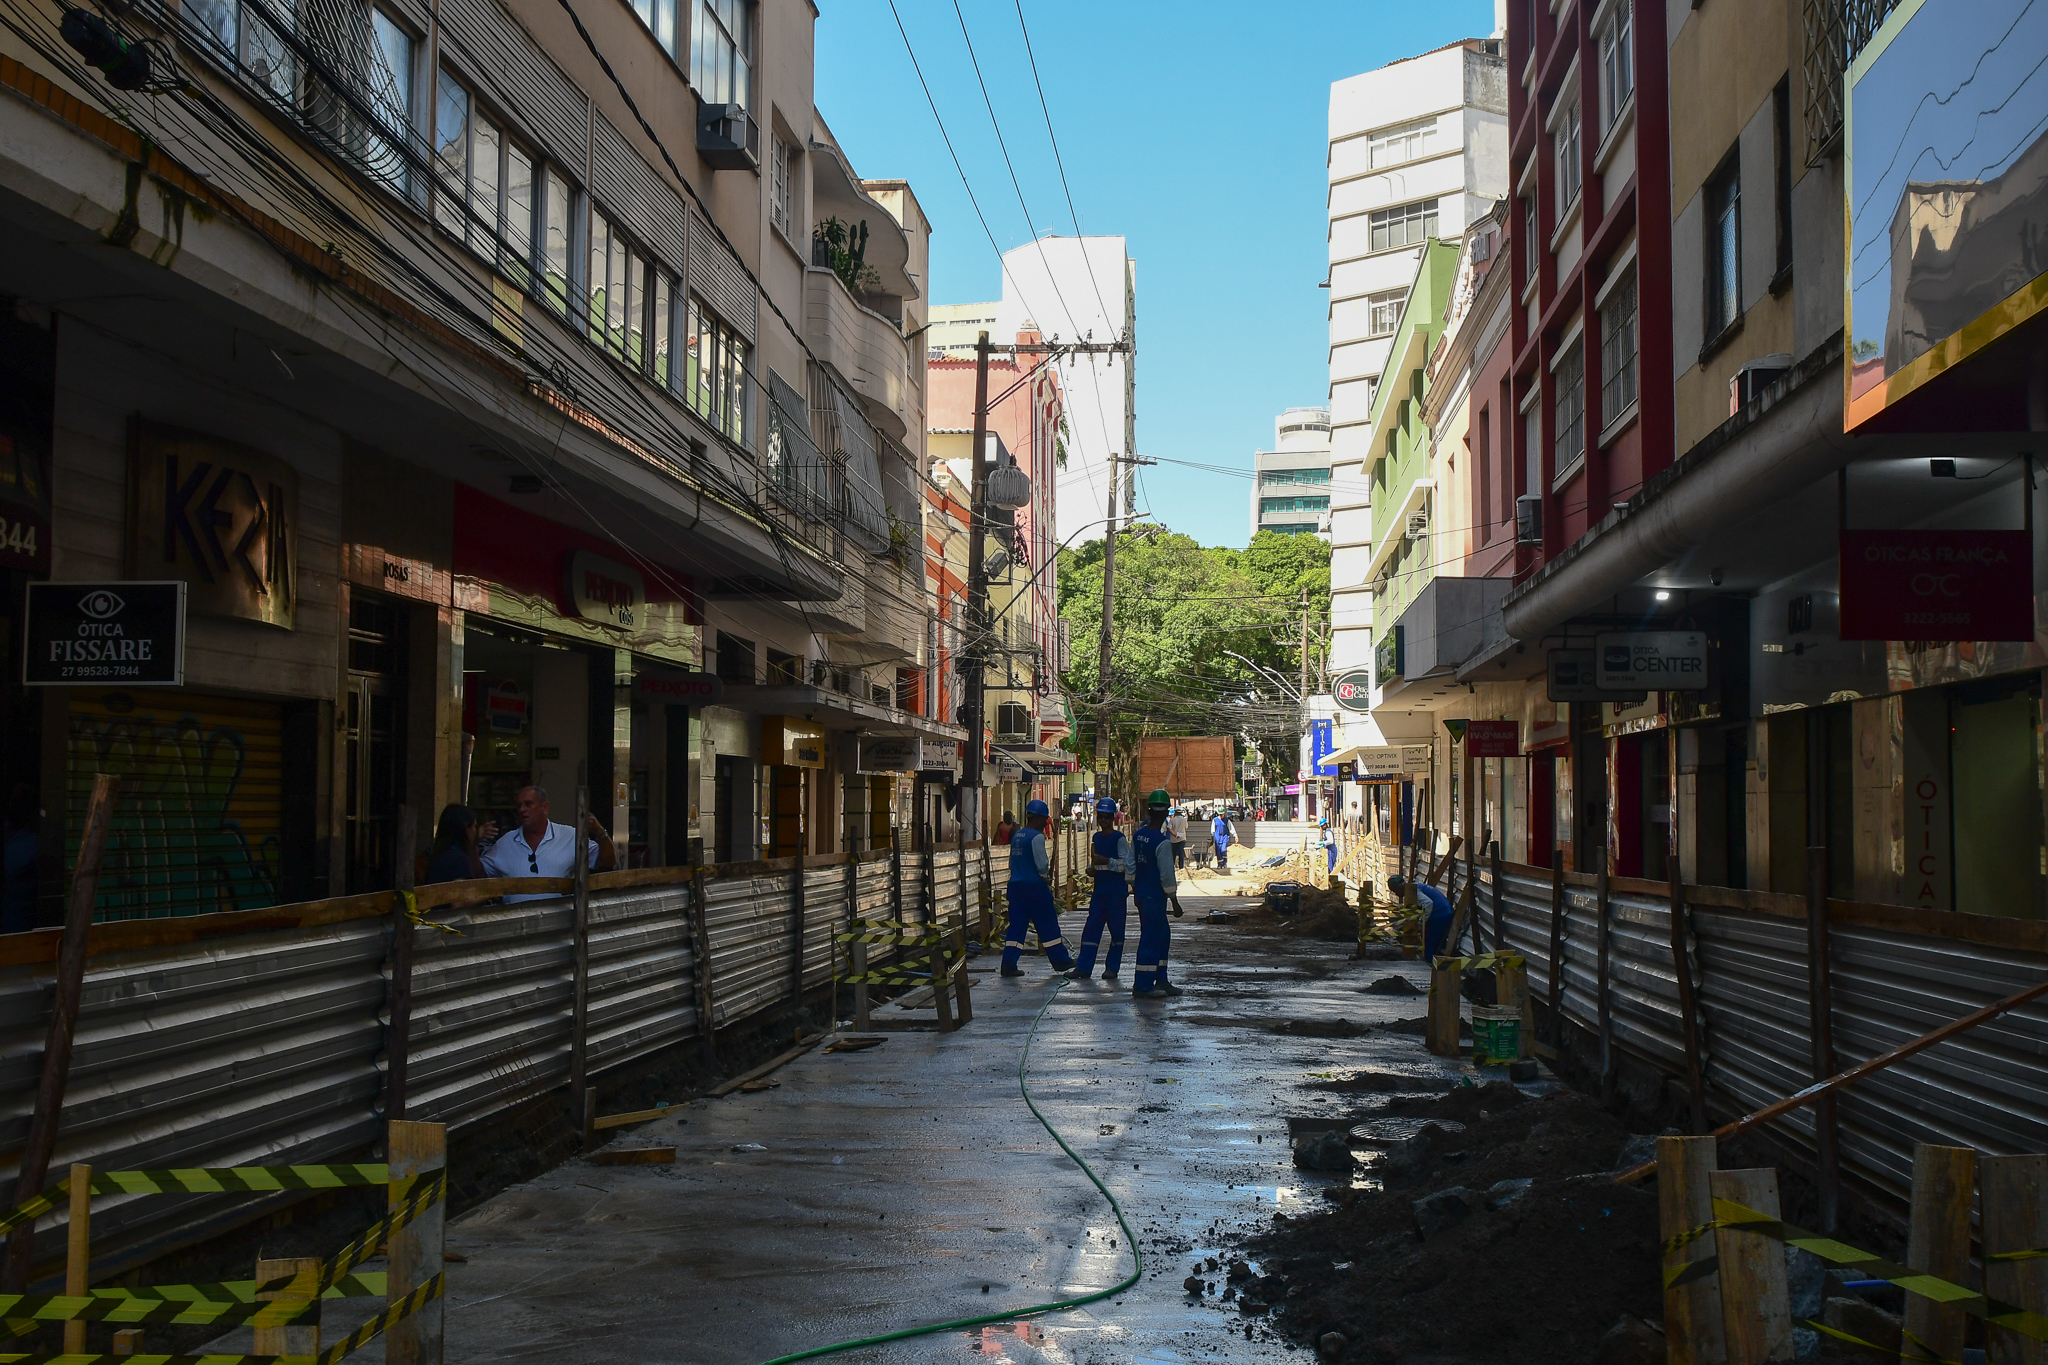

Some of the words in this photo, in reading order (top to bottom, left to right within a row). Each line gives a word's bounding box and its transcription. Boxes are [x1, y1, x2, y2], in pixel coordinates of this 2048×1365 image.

[1935, 546, 2009, 567] FRANÇA
[585, 570, 634, 615] PEIXOTO
[77, 620, 124, 637] ÓTICA
[49, 639, 152, 661] FISSARE
[1632, 646, 1660, 654] ÓTICA
[61, 667, 75, 676] 27
[77, 665, 140, 676] 99528-7844
[1632, 656, 1703, 673] CENTER
[640, 679, 713, 698] PEIXOTO
[1916, 774, 1937, 909] ÓTICA
